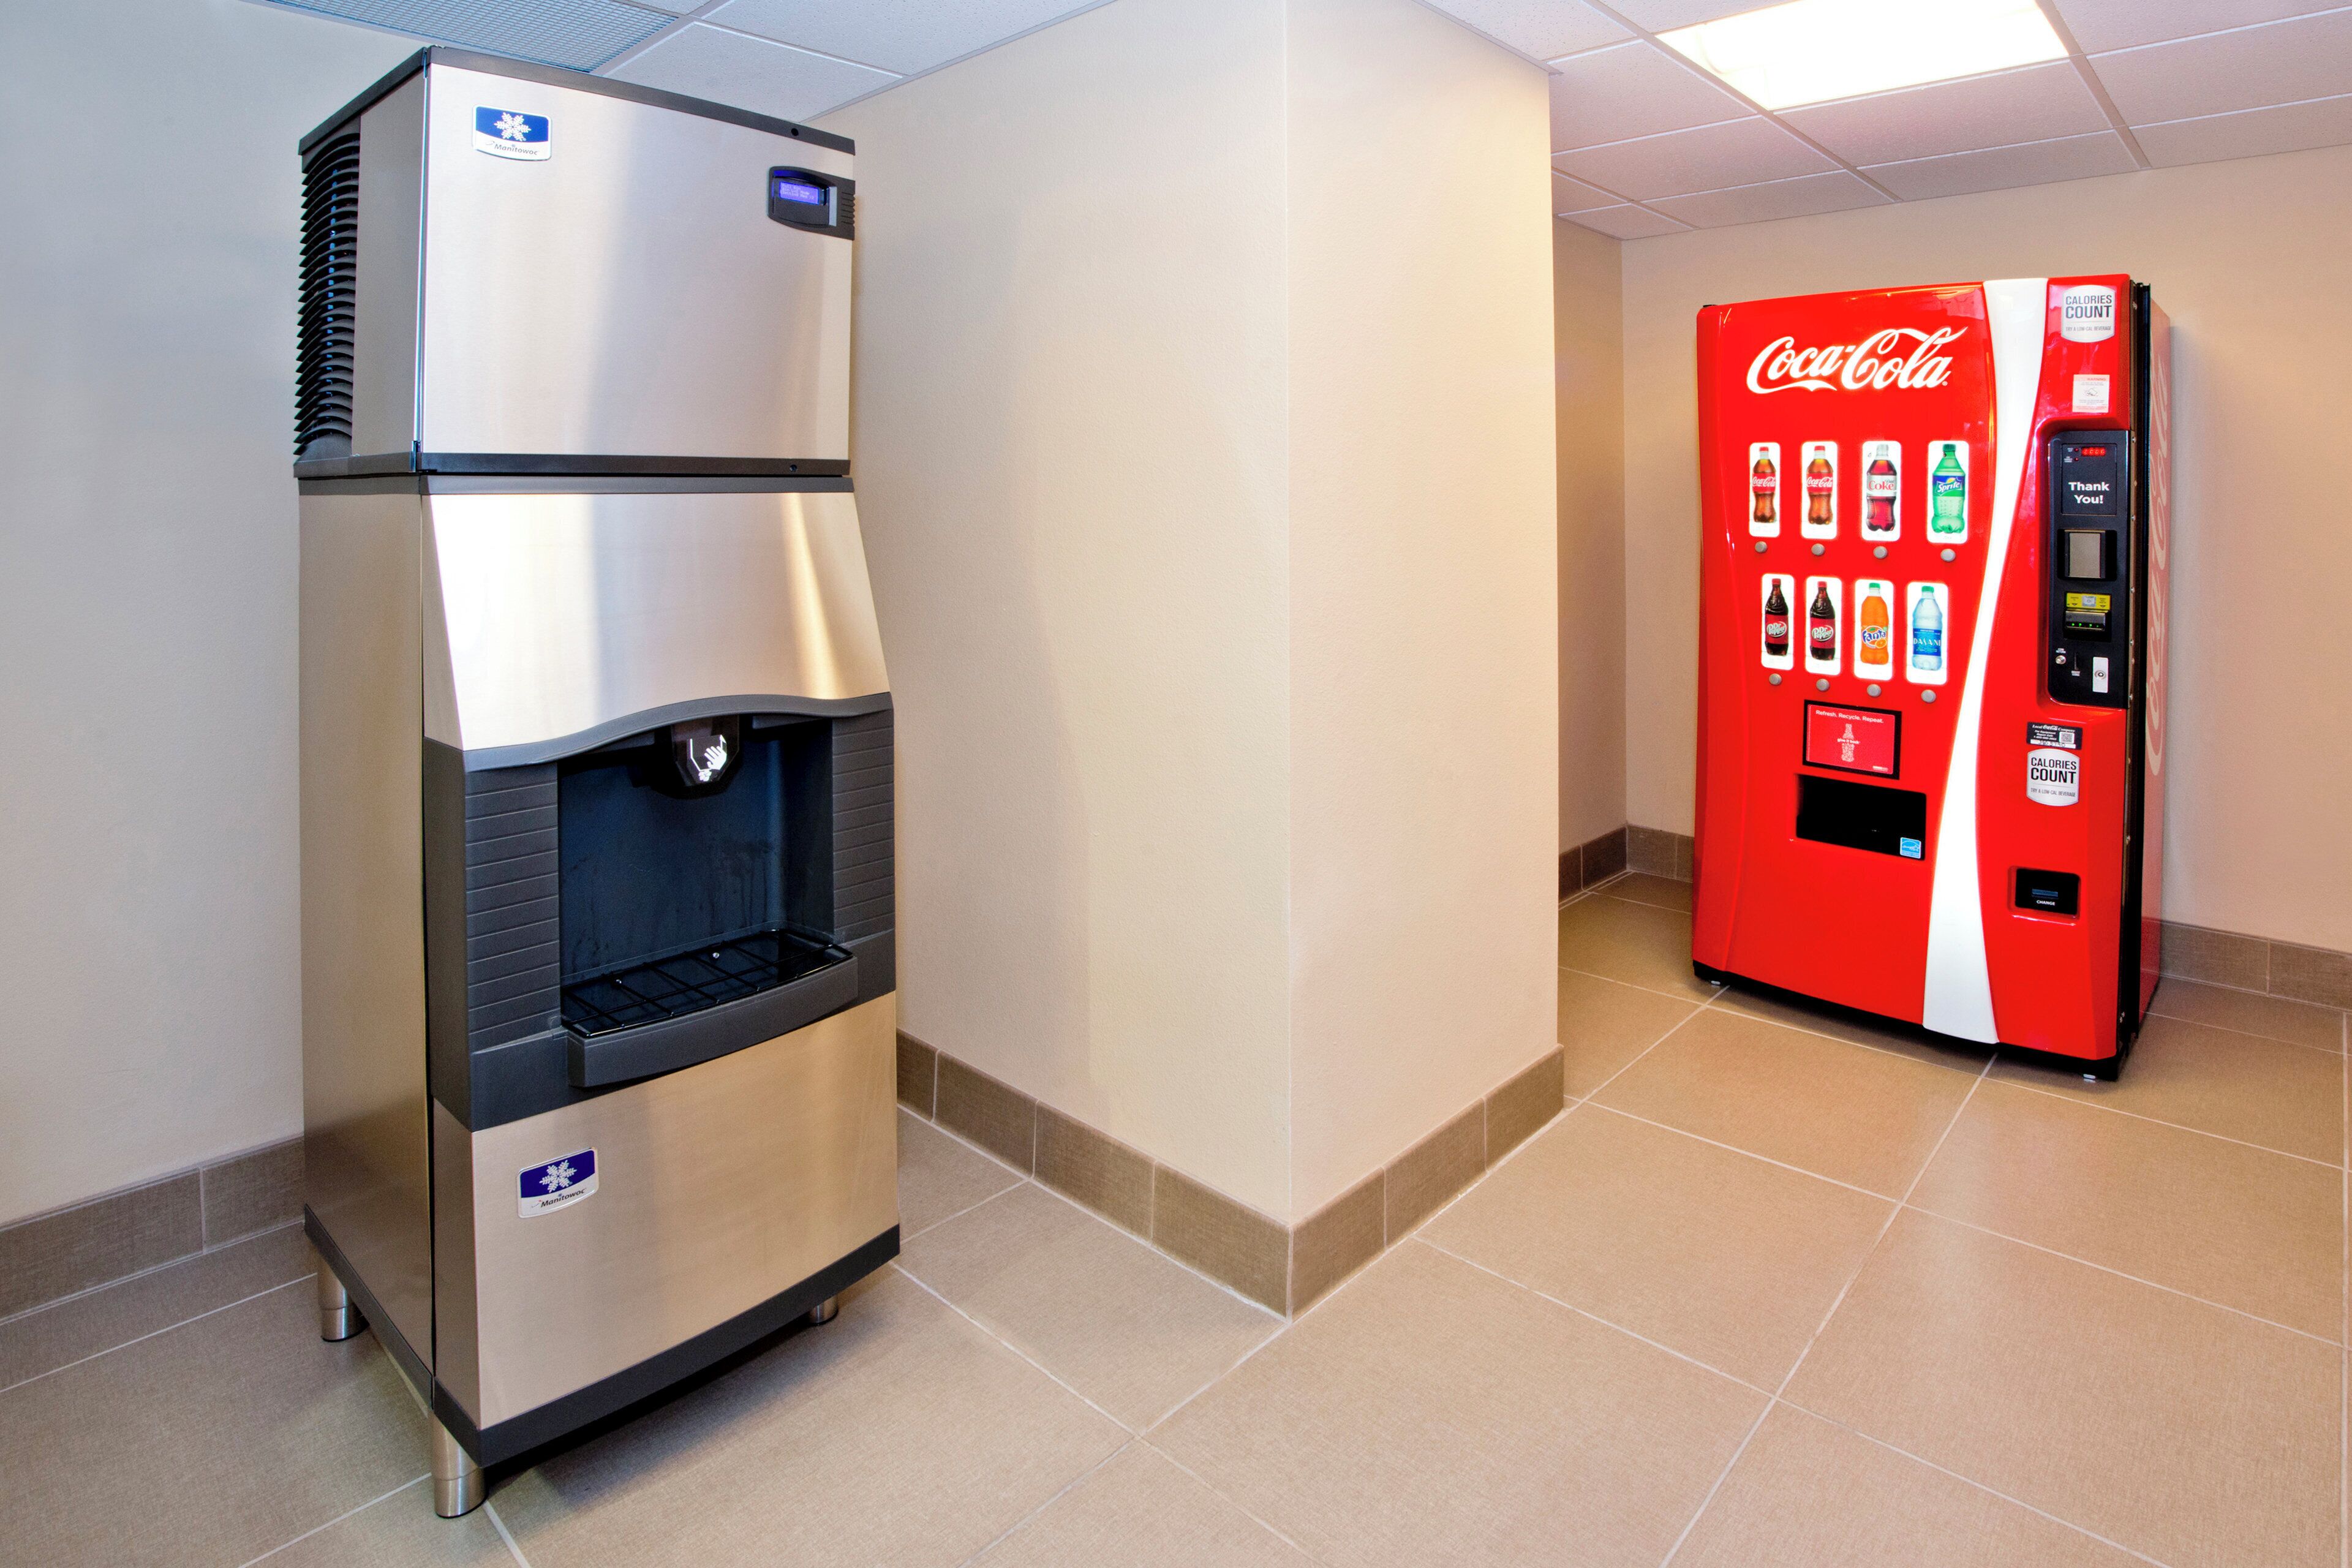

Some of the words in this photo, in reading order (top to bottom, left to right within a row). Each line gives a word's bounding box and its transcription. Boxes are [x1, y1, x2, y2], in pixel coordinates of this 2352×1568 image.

[494, 143, 538, 156] Manitowoc
[2065, 295, 2112, 305] CALORIES
[2065, 305, 2112, 318] COUNT
[1746, 326, 1968, 394] Coca-Cola
[1869, 480, 1894, 491] Coke
[1937, 481, 1961, 493] Sprite
[2068, 481, 2110, 491] Thank
[2074, 494, 2103, 504] You!
[1768, 624, 1785, 635] Pepper
[1813, 628, 1832, 639] Pepper
[1862, 629, 1887, 643] Fanta
[1913, 638, 1941, 647] DASANI
[2031, 757, 2076, 770] CALORIES
[2030, 767, 2076, 784] COUNT
[540, 1188, 586, 1208] Manitowoc
